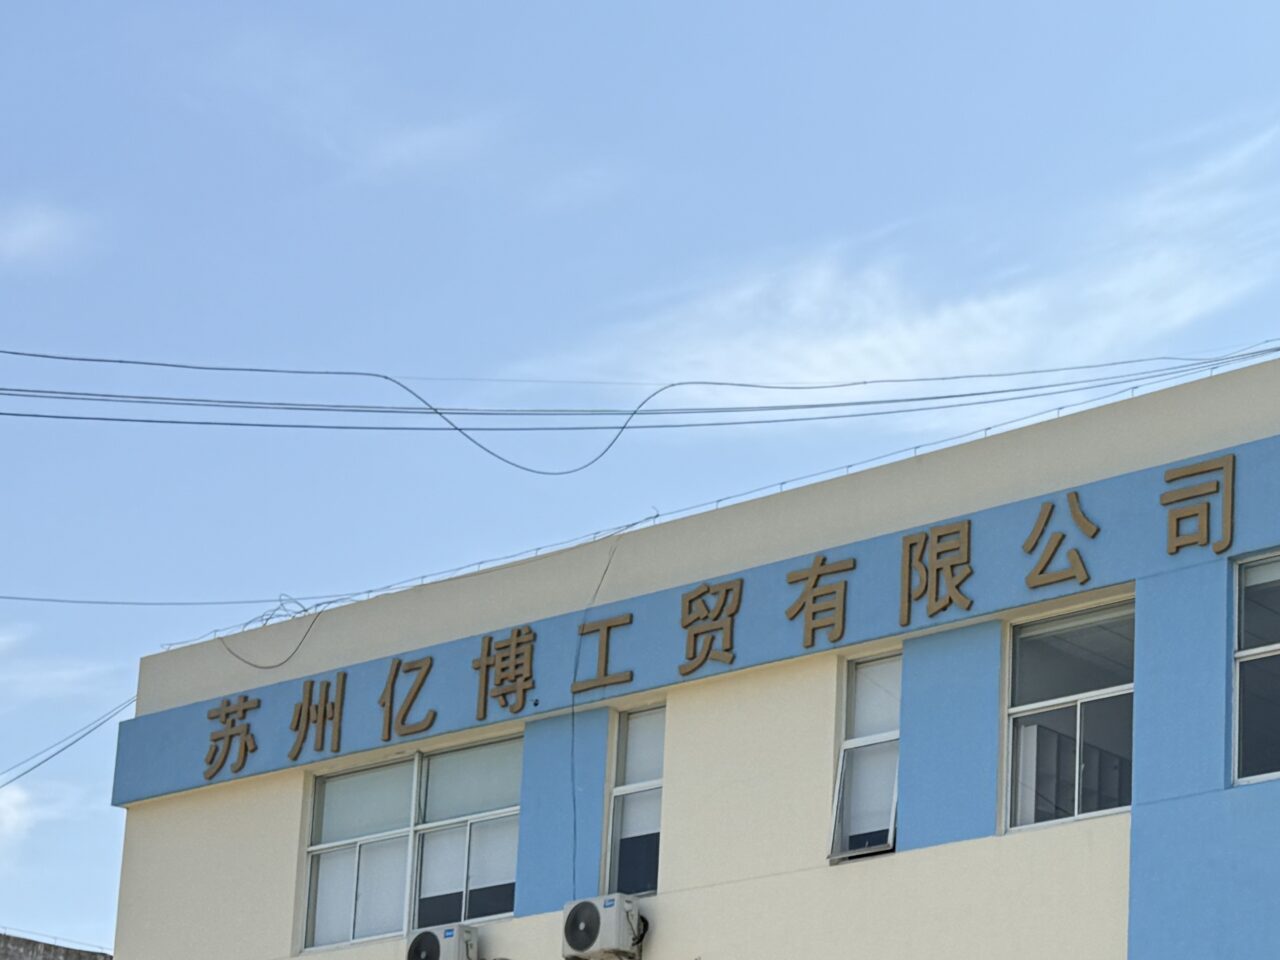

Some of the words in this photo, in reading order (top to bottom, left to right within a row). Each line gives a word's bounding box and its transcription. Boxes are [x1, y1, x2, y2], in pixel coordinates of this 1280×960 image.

[203, 454, 1236, 780] 苏州亿博工贸有限公司
